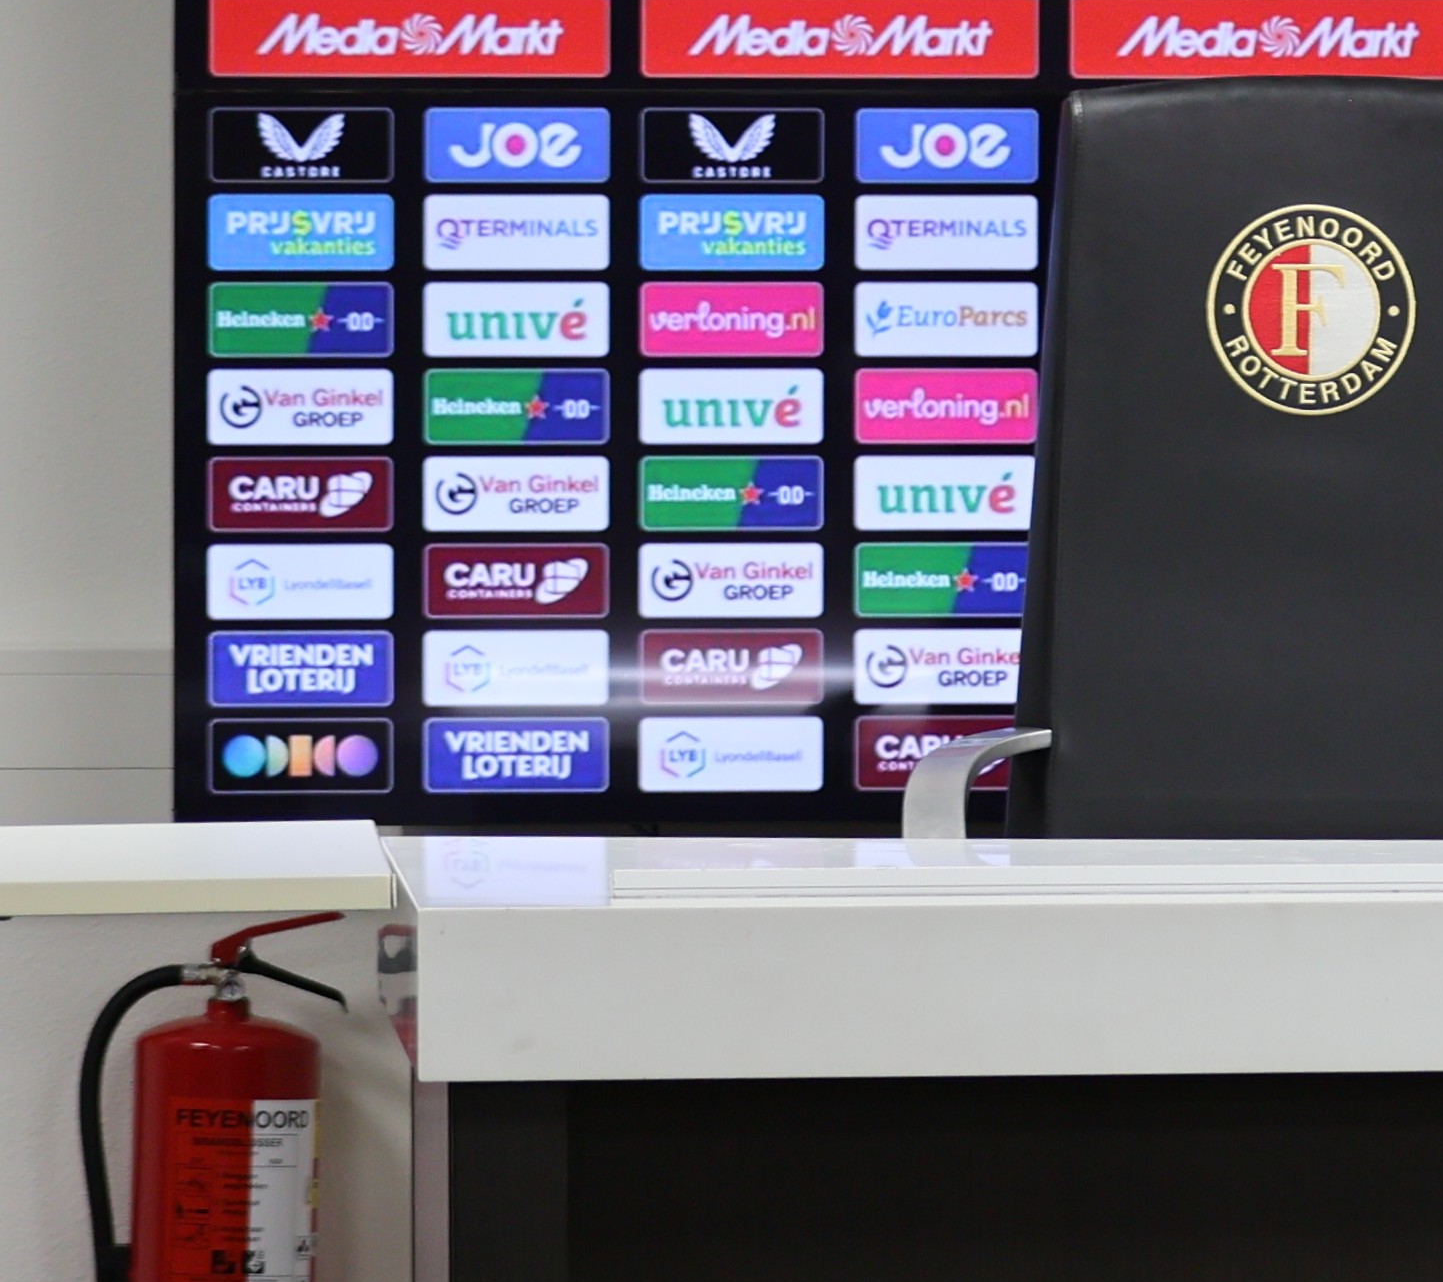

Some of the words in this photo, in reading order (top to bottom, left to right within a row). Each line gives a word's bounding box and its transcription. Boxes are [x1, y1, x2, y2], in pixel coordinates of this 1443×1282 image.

[449, 121, 581, 167] JOE
[878, 122, 1010, 168] JOE
[437, 217, 598, 241] QTERMINALS
[866, 218, 1026, 242] QTERMINALS
[270, 236, 376, 255] vakanties
[701, 237, 806, 255] vakanties
[1226, 215, 1397, 282] FEYENOORD
[218, 311, 306, 328] Heineken
[447, 298, 588, 340] univé
[649, 301, 815, 339] verloning.nl
[897, 305, 1028, 328] EuroParcs
[1225, 335, 1398, 405] ROTTERDAM
[264, 389, 306, 405] Van
[313, 388, 383, 406] Ginkel
[434, 398, 521, 415] Heineken
[662, 386, 803, 427] univé
[864, 388, 1030, 426] verloning.nl
[293, 411, 364, 426] GROEP
[230, 475, 320, 500] CARU
[479, 476, 522, 492] Van
[529, 475, 599, 493] Ginkel
[649, 485, 737, 502] Heineken
[877, 473, 1017, 514] univé
[509, 498, 579, 513] GROEP
[446, 563, 535, 587] CARU
[864, 573, 951, 590] Heineken
[229, 644, 373, 666] VRIENDEN
[245, 669, 355, 693] LOTERIJ
[444, 732, 589, 754] VRIENDEN
[461, 756, 571, 781] LOTERIJ
[176, 1108, 309, 1129] FEYENOORD
